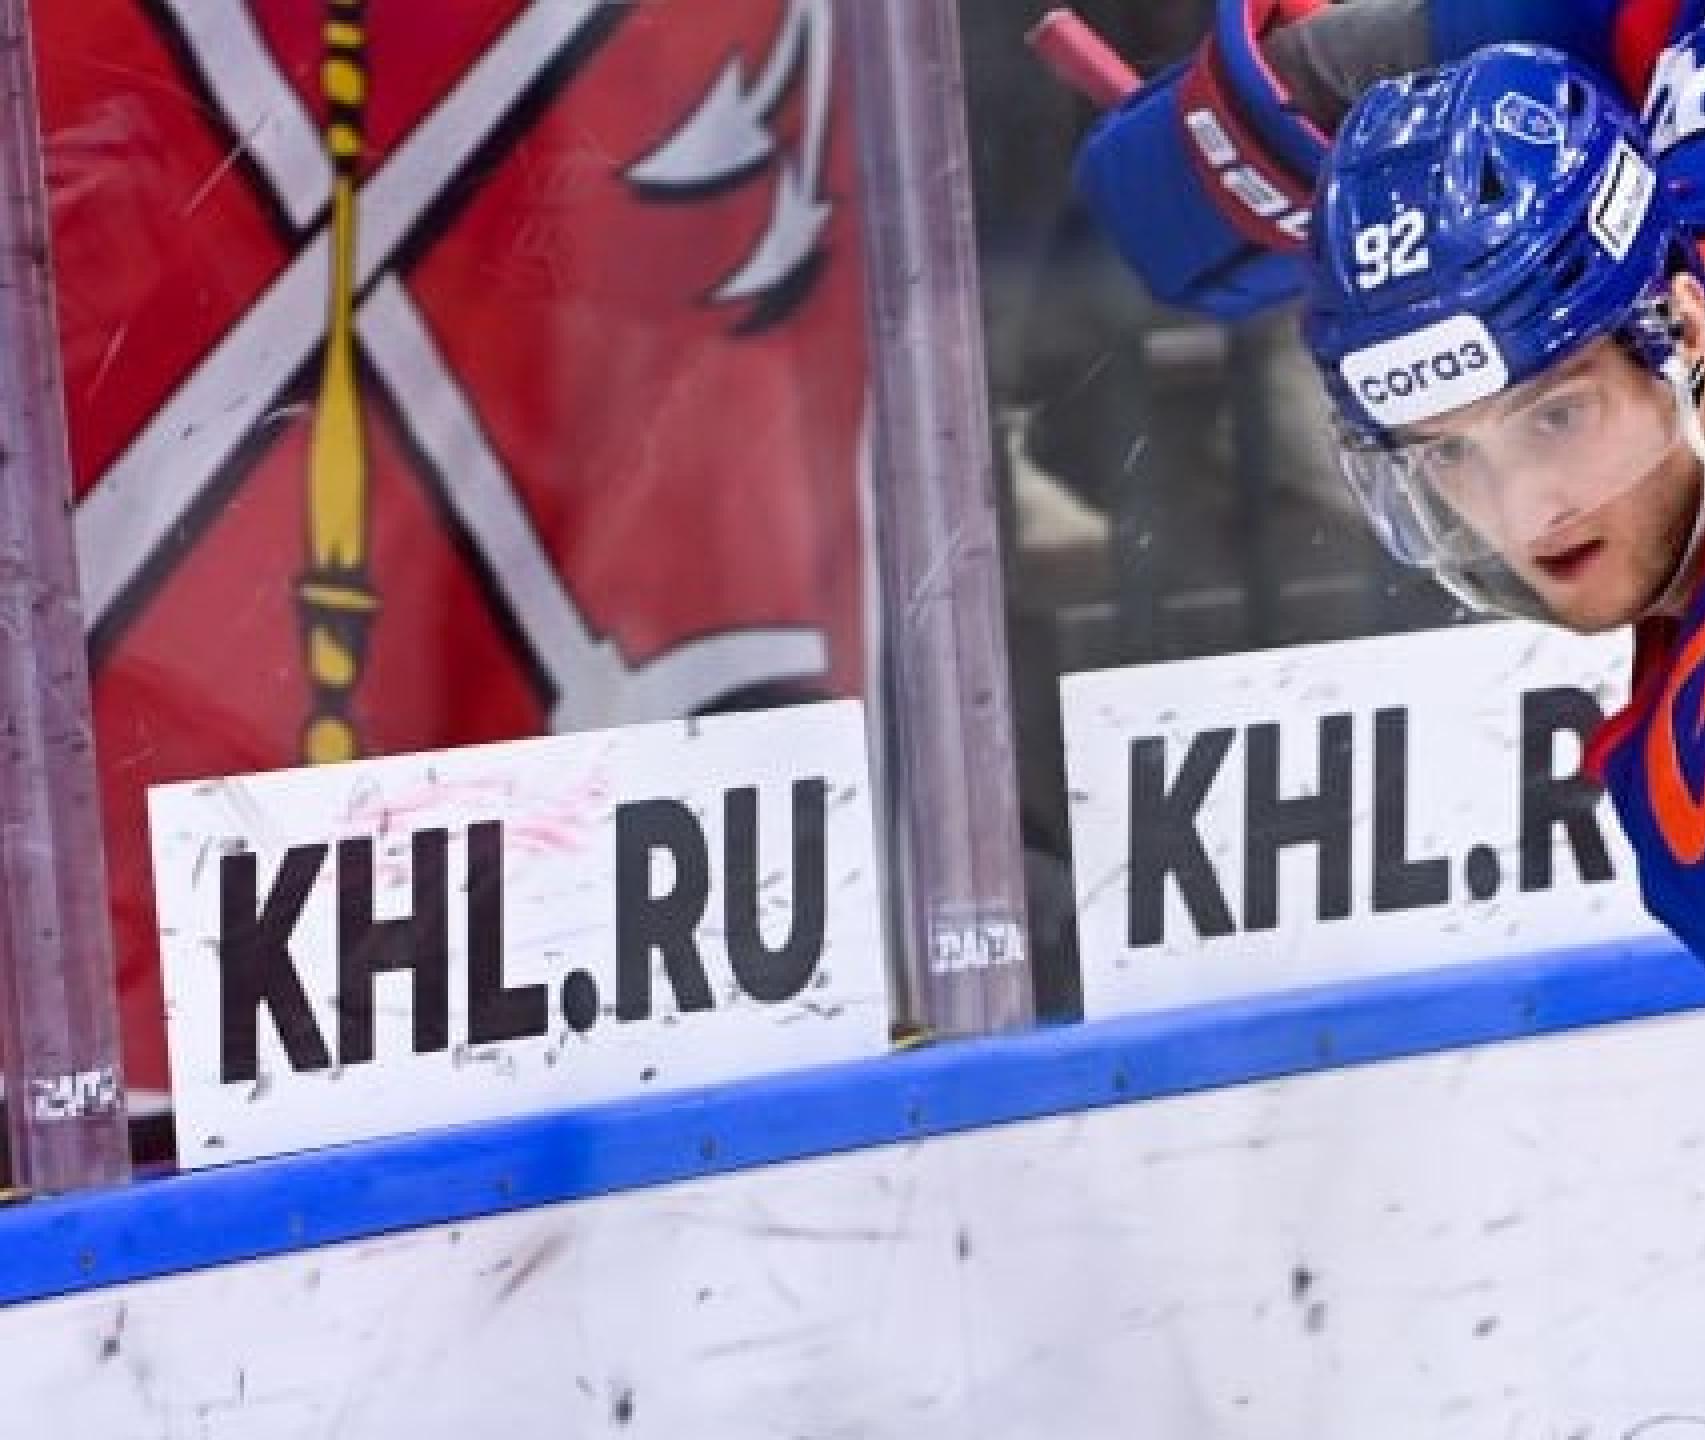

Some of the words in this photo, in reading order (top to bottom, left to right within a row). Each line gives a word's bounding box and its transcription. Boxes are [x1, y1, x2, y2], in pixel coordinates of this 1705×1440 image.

[1354, 210, 1432, 290] 92
[216, 775, 830, 1086] KHL.RU
[1126, 685, 1618, 950] KHL.R
